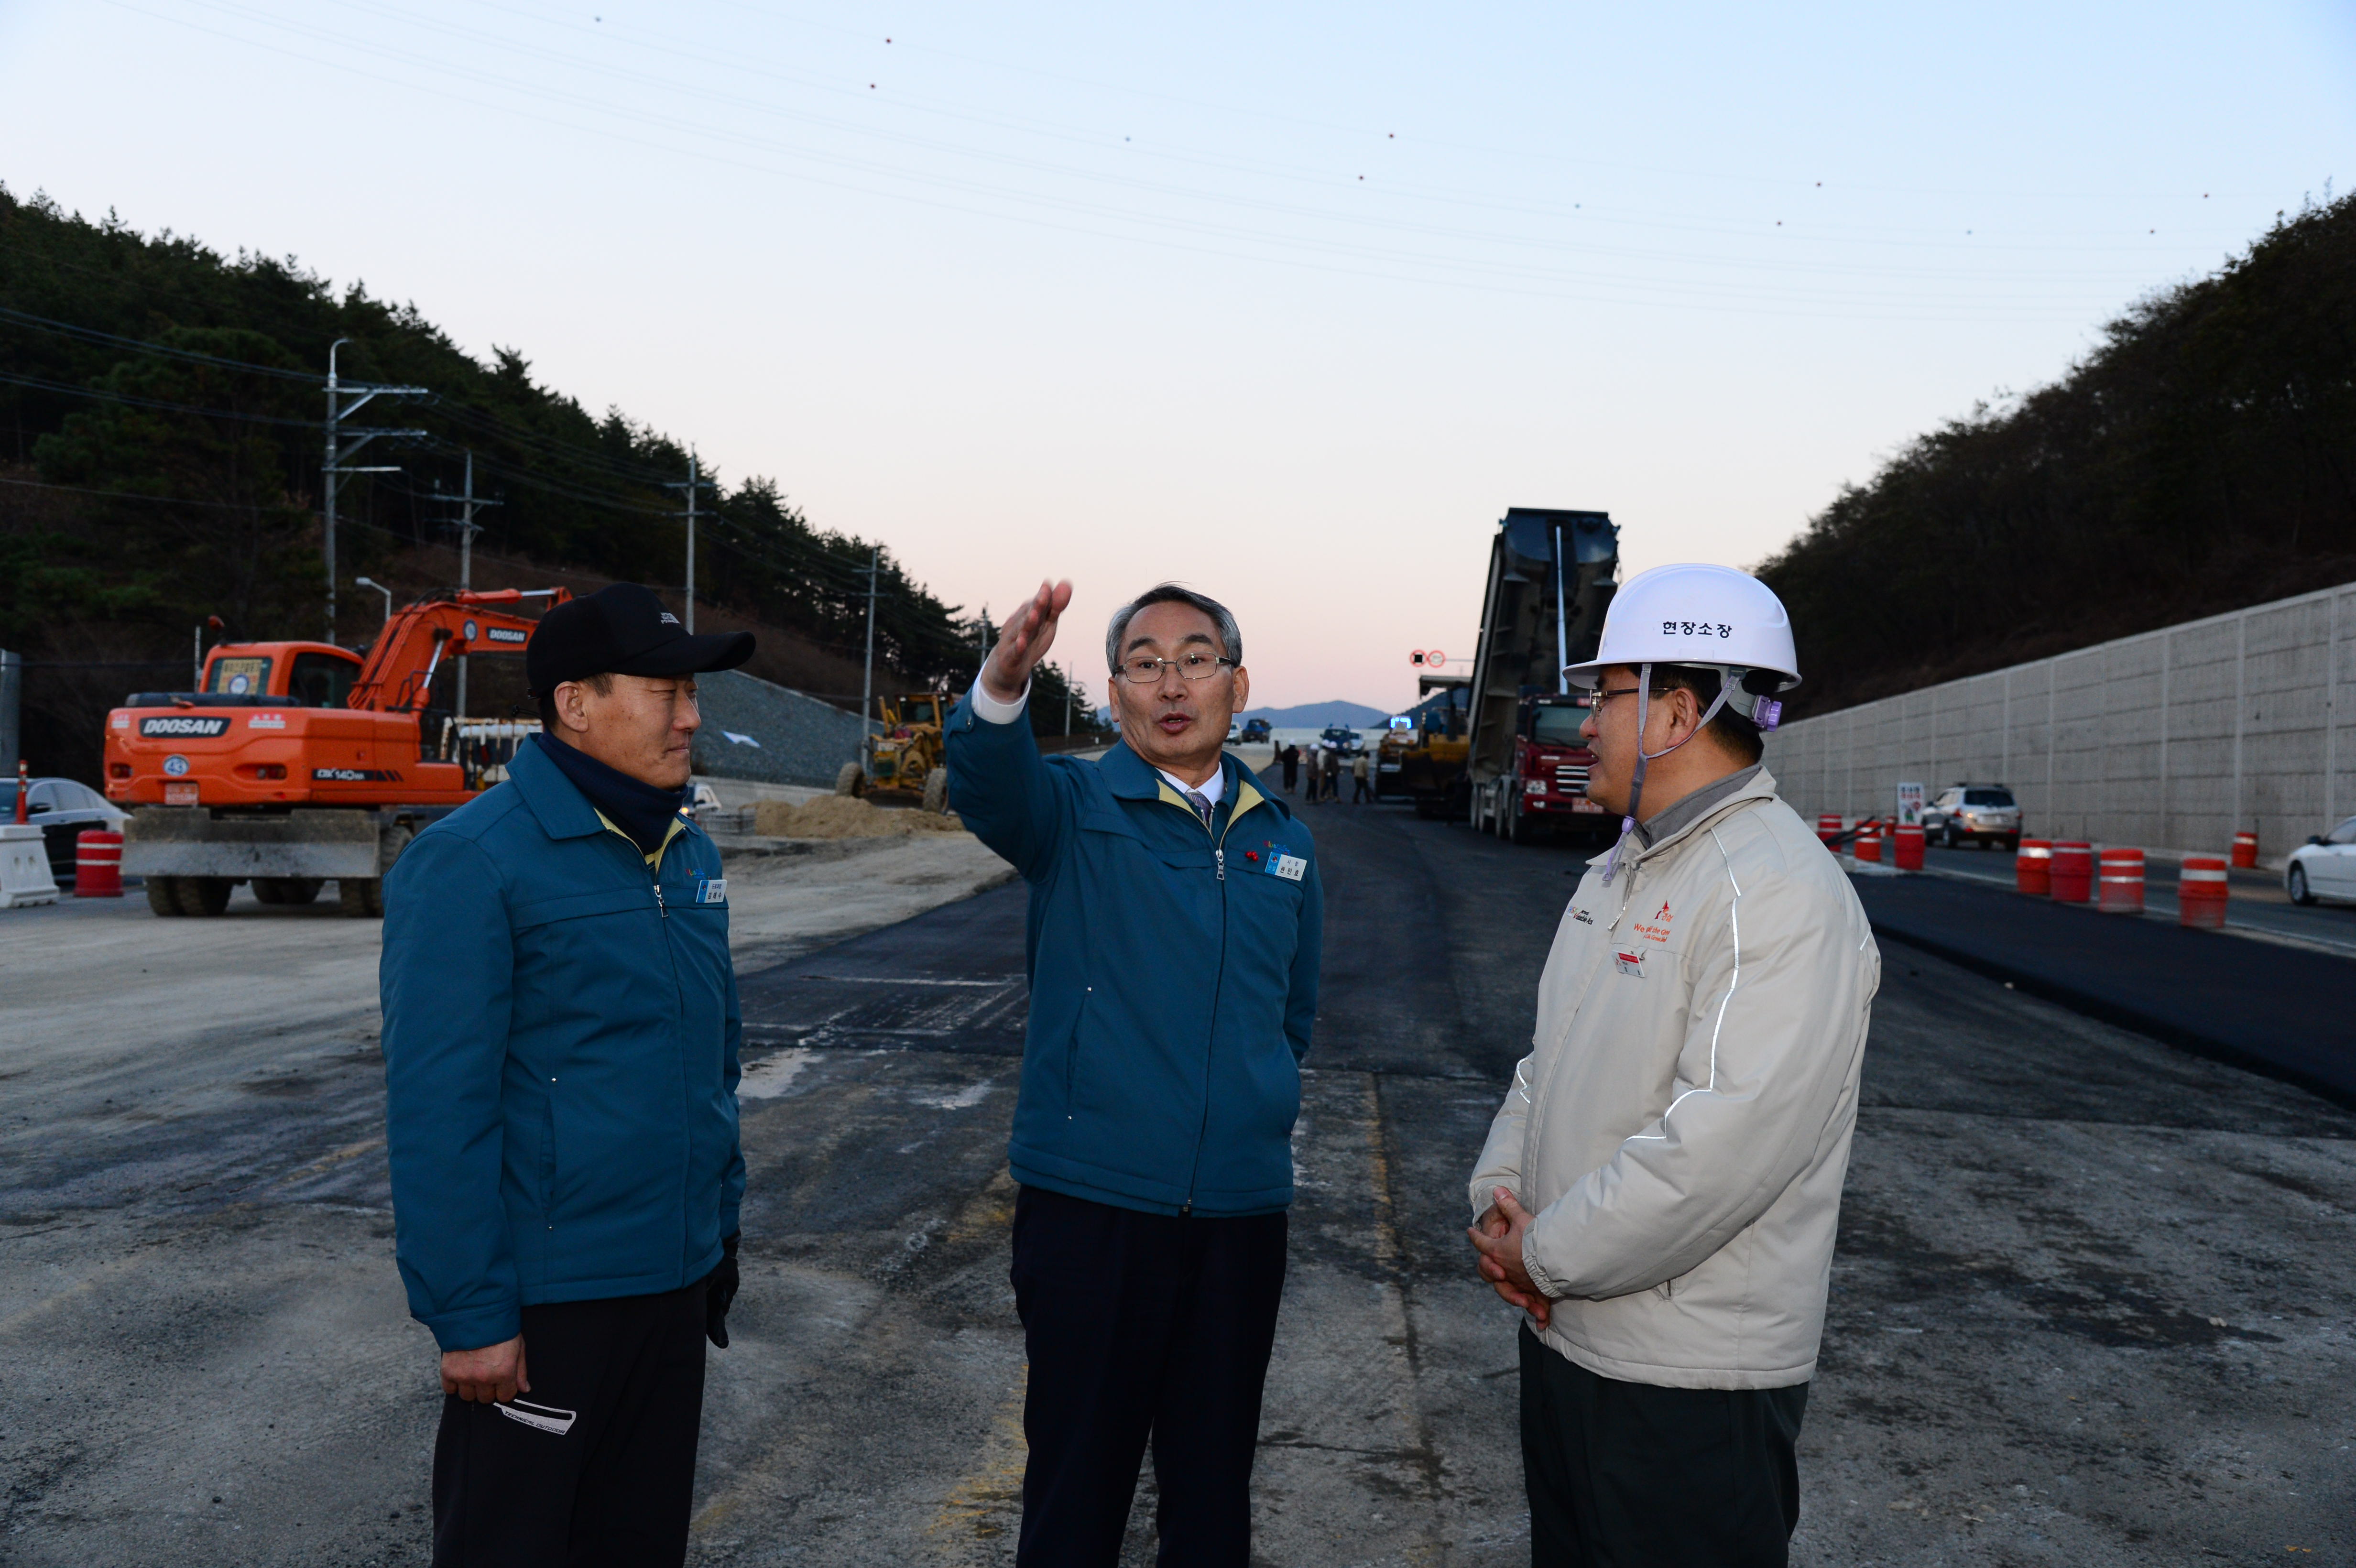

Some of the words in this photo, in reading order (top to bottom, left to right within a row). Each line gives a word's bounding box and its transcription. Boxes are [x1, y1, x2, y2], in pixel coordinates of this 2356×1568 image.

[489, 629, 525, 642] DOOSAN
[1663, 621, 1732, 639] 현장소장
[143, 719, 223, 735] DOOSAN
[1634, 923, 1645, 933] We
[504, 1411, 535, 1425] TECHNICAL
[536, 1423, 566, 1434] OUTDOOR
